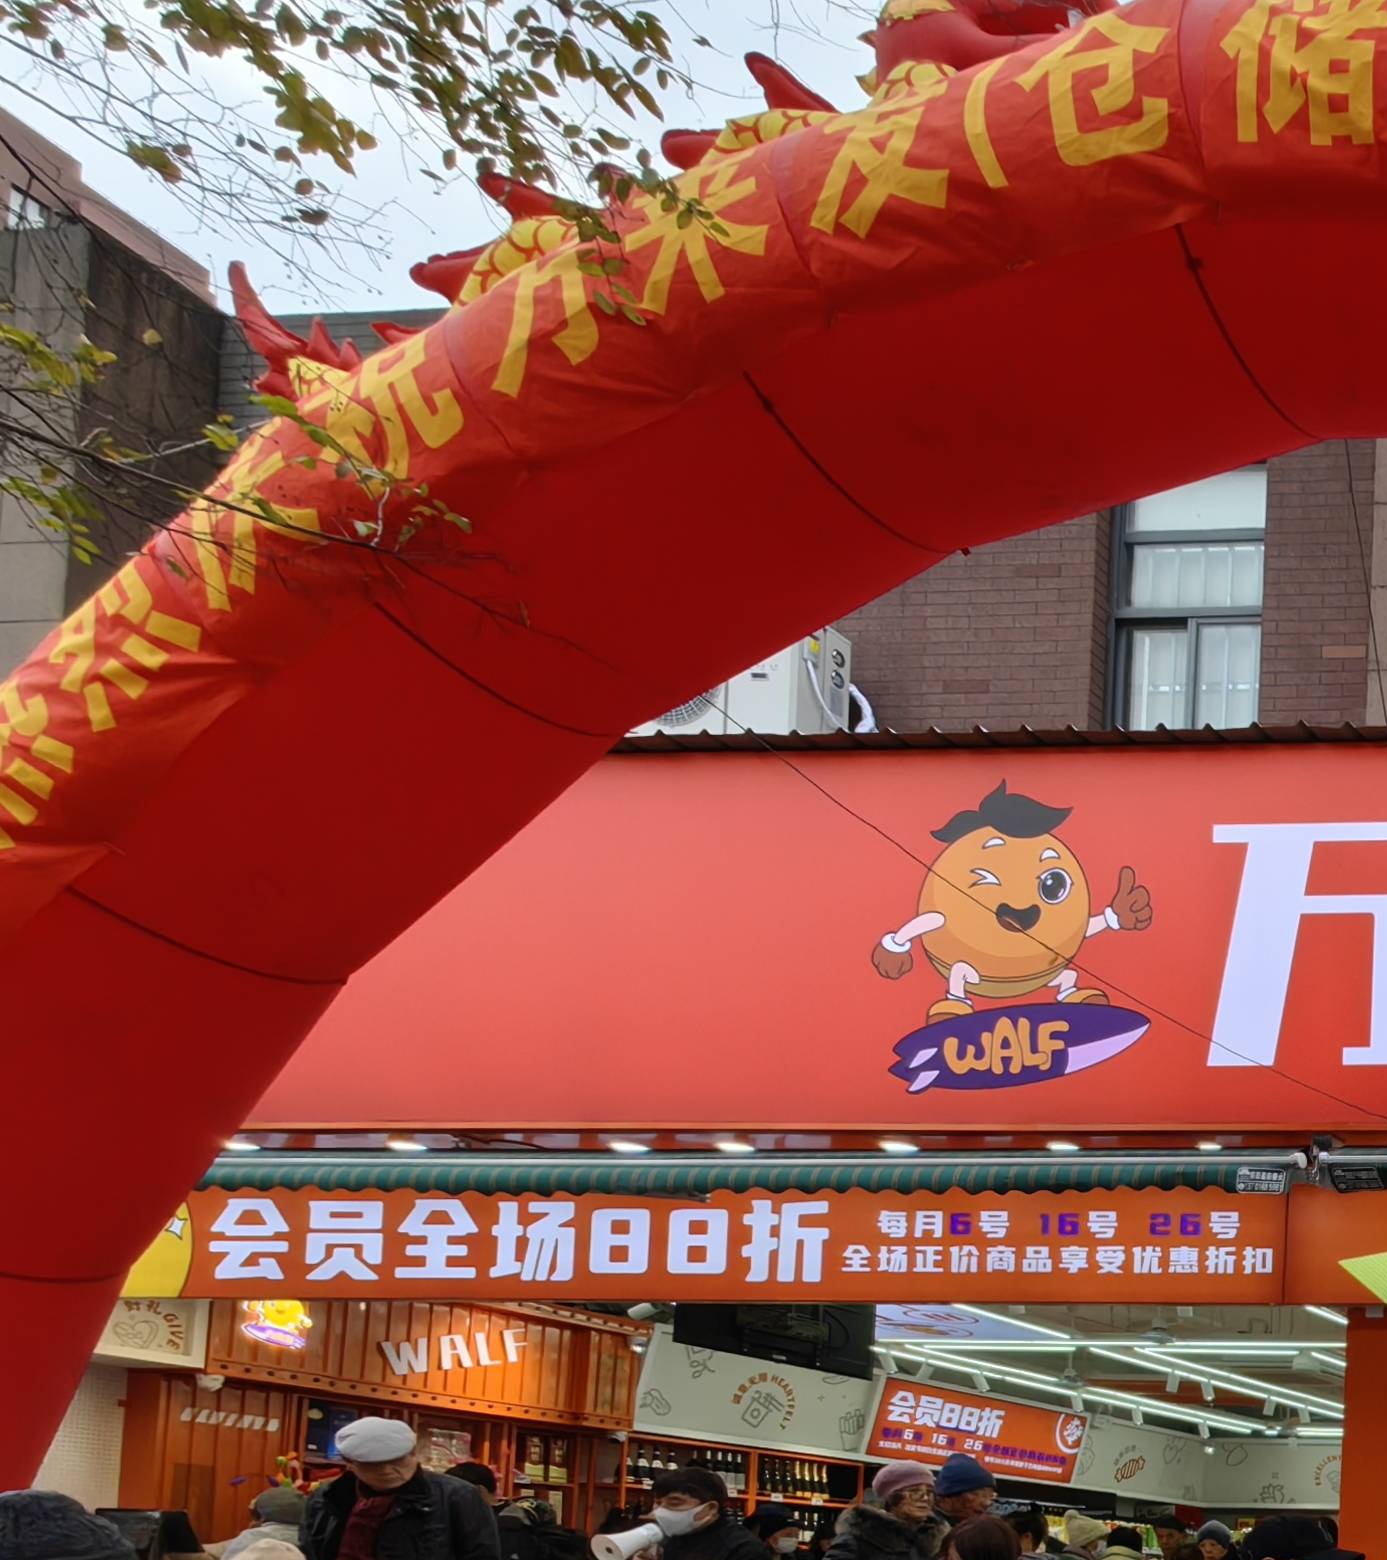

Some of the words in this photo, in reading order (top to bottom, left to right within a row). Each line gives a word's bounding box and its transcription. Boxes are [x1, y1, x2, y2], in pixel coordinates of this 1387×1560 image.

[942, 1016, 1070, 1077] WALF
[208, 1198, 830, 1284] 会员全场88折
[877, 1210, 1010, 1239] 每月6号
[1040, 1210, 1118, 1239] 16号
[1149, 1210, 1241, 1239] 26号
[841, 1243, 1274, 1276] 全场正价商品享受优惠折扣
[381, 1328, 529, 1375] WALF
[887, 1390, 1006, 1438] 会员88折
